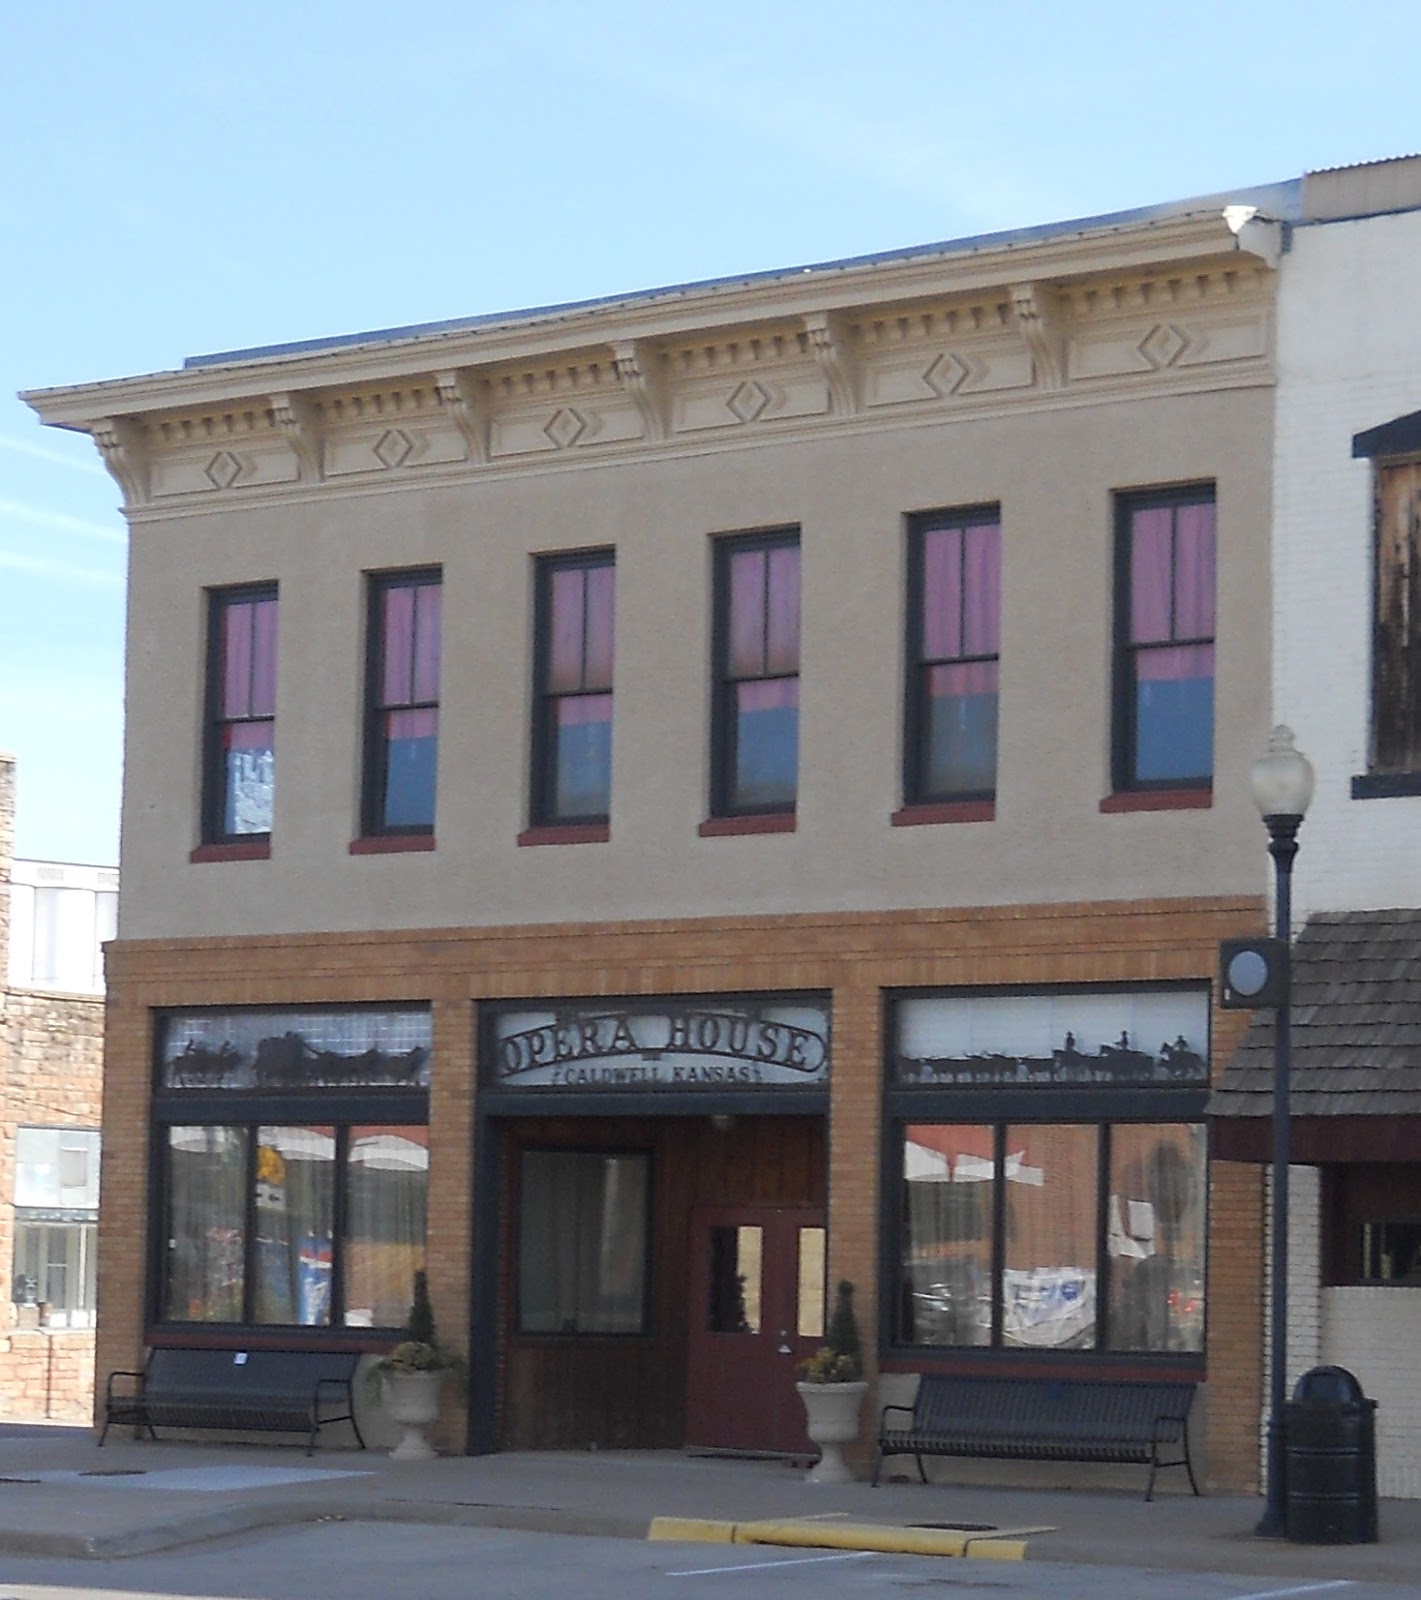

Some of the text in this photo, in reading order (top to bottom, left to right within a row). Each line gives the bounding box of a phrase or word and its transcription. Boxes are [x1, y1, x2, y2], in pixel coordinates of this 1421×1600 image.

[502, 1015, 809, 1074] OPERA HOUSE
[564, 1066, 750, 1083] CALDWELL KANSAS
